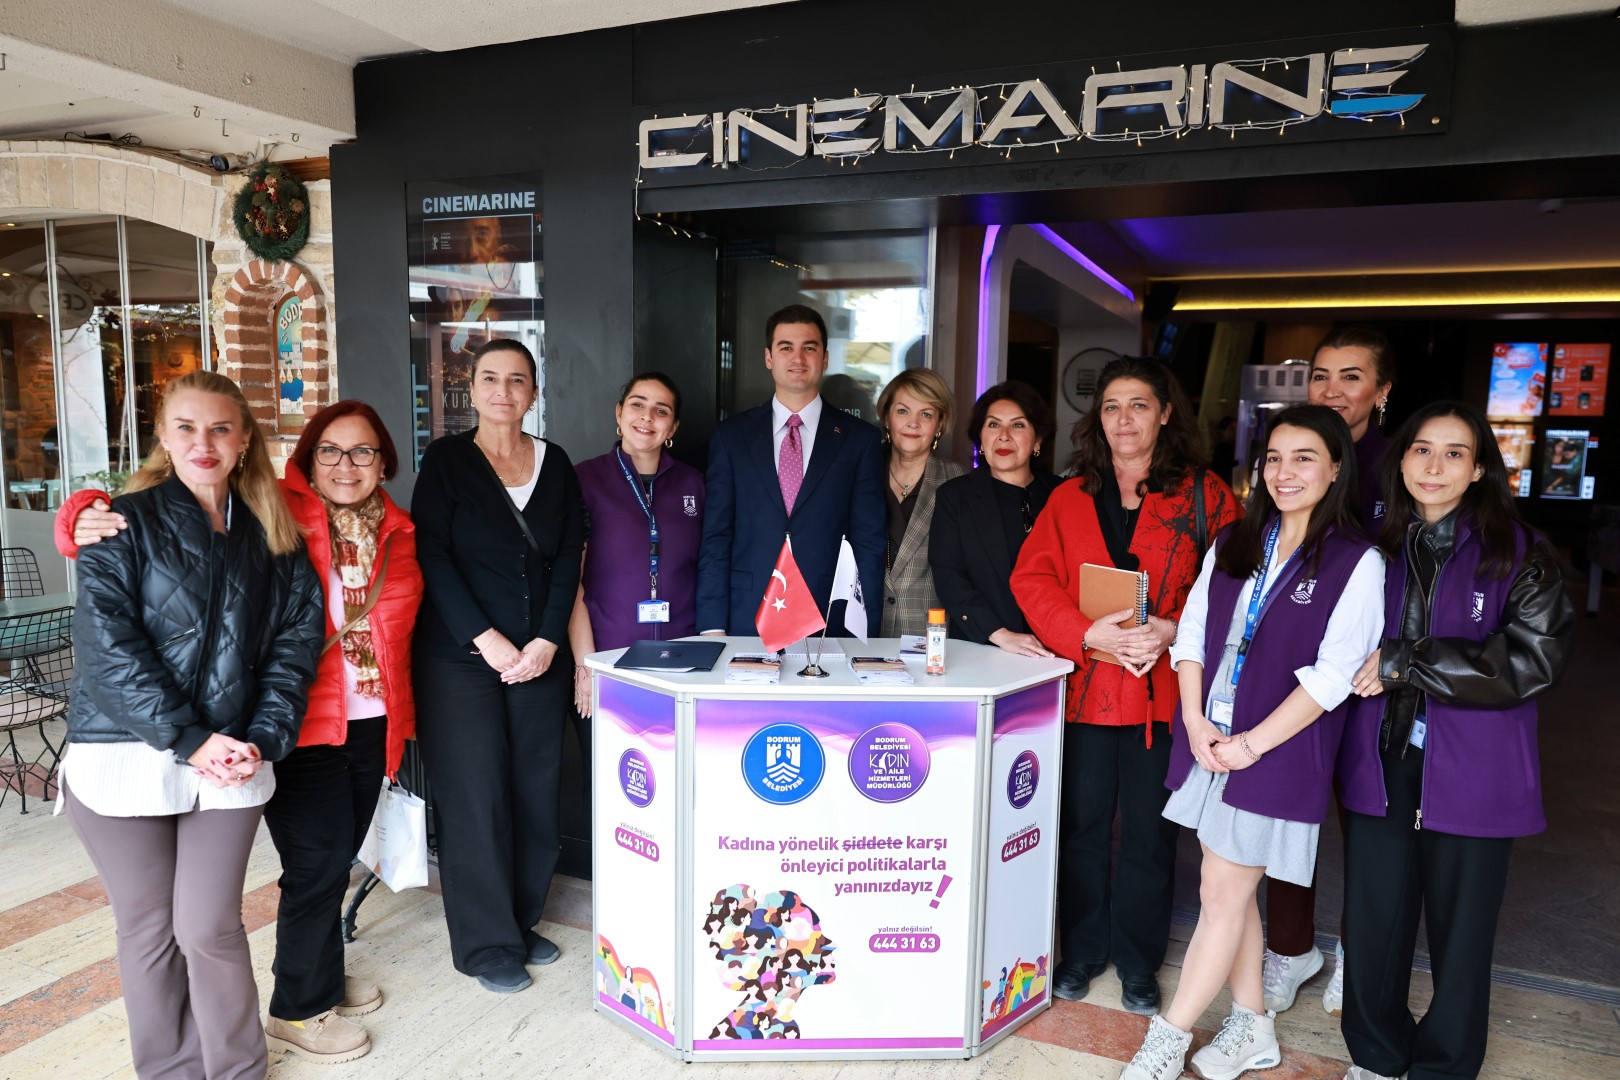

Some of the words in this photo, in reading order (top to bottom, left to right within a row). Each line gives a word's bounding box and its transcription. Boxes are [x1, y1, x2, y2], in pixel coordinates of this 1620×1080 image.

[639, 43, 1429, 168] CINEMARINE
[422, 191, 536, 214] CINEMARINE
[441, 391, 470, 409] KUR
[888, 767, 905, 775] AİLE
[762, 776, 805, 792] BELEDİYESİ
[866, 781, 912, 789] MÜDÜRLÜĞÜ
[617, 831, 634, 848] 444
[634, 838, 645, 853] 31
[646, 843, 657, 859] 63
[718, 836, 775, 850] Kadına
[779, 836, 839, 854] yönelik
[843, 836, 902, 852] şiddete
[906, 835, 947, 851] karşı
[1003, 842, 1018, 858] 444
[1019, 836, 1028, 851] 31
[1029, 831, 1038, 846] 63
[781, 858, 844, 876] önleyici
[847, 857, 947, 875] politikalarla
[878, 926, 899, 934] yalnız
[901, 926, 933, 934] değilsin!
[873, 937, 898, 949] 444
[901, 937, 916, 949] 31
[919, 937, 936, 949] 63
